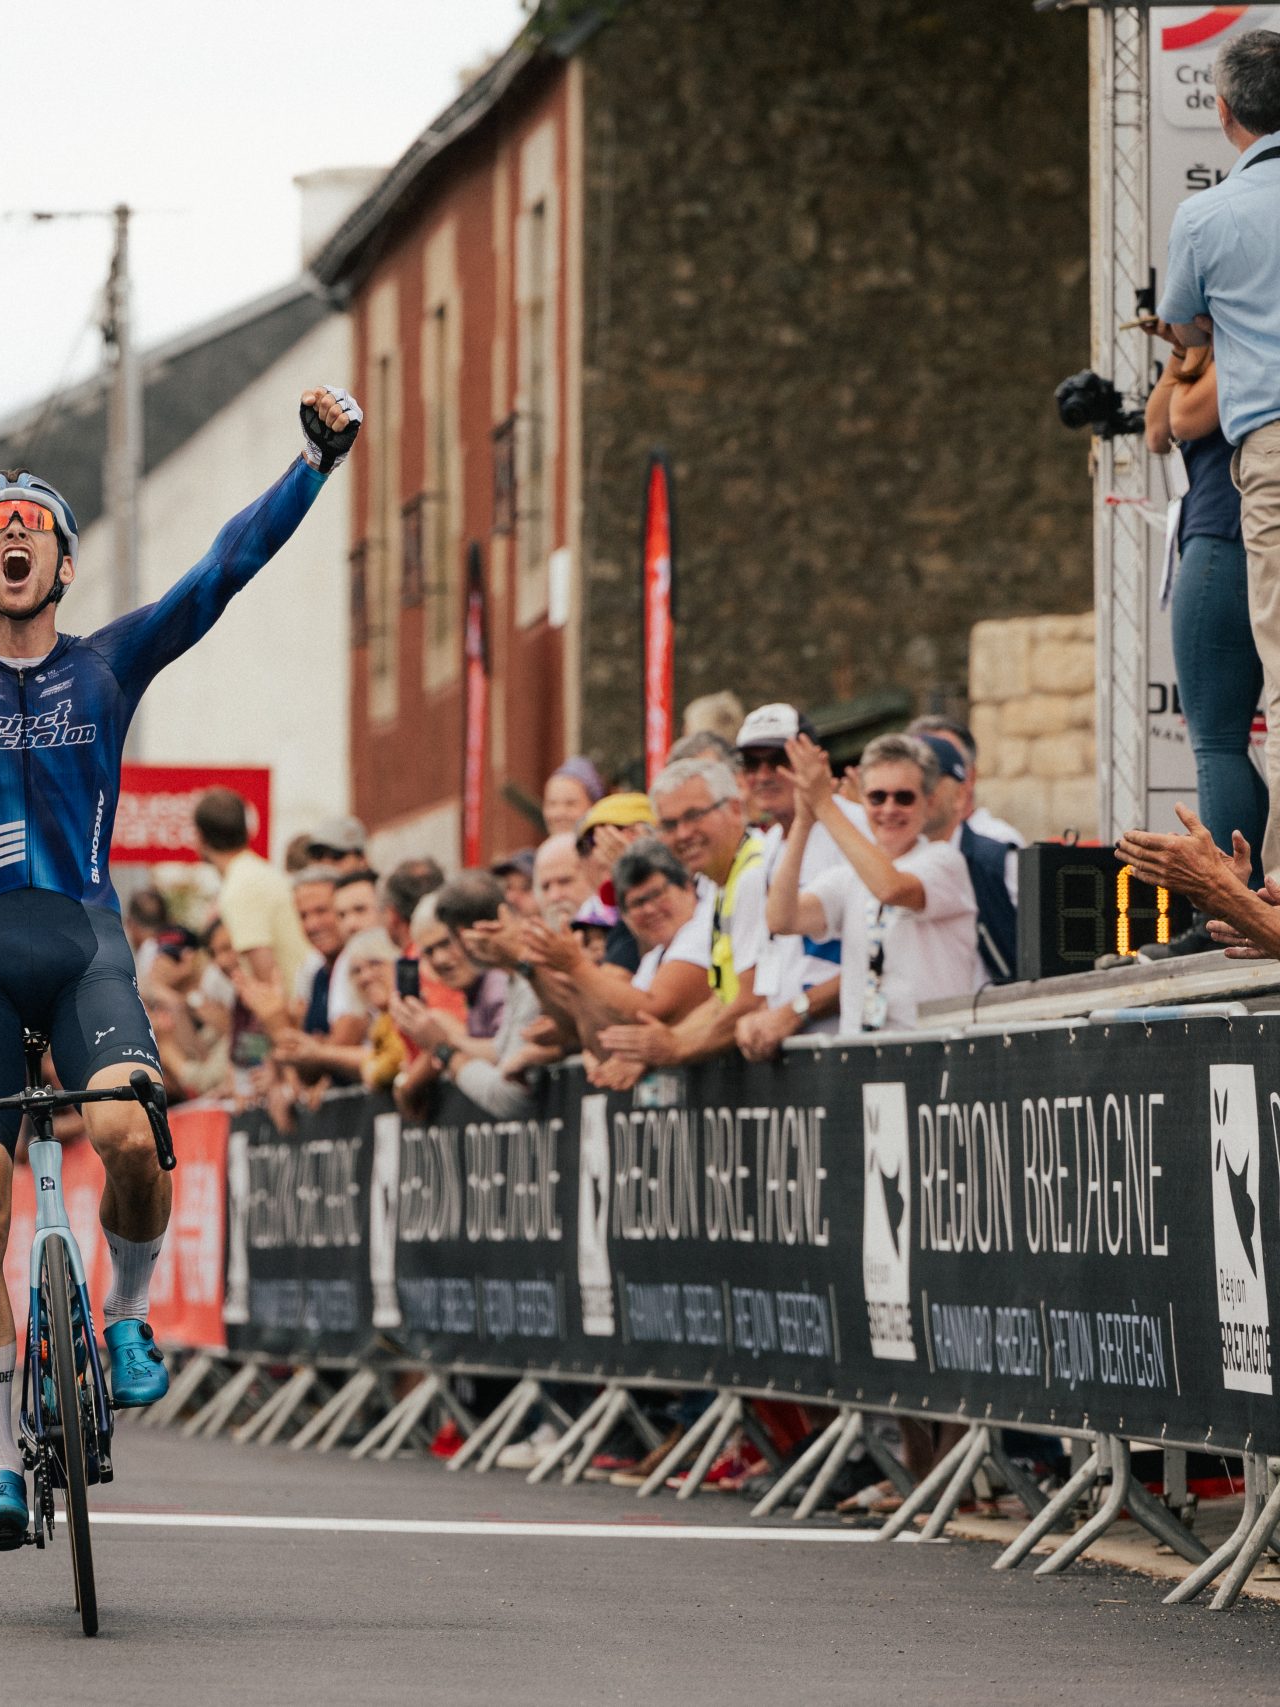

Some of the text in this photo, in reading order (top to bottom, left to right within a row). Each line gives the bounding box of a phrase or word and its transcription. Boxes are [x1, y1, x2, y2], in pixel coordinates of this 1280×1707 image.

[91, 789, 105, 884] ARGON 18
[918, 1071, 1013, 1253] RÉGION
[1022, 1093, 1168, 1256] BRETAGNE
